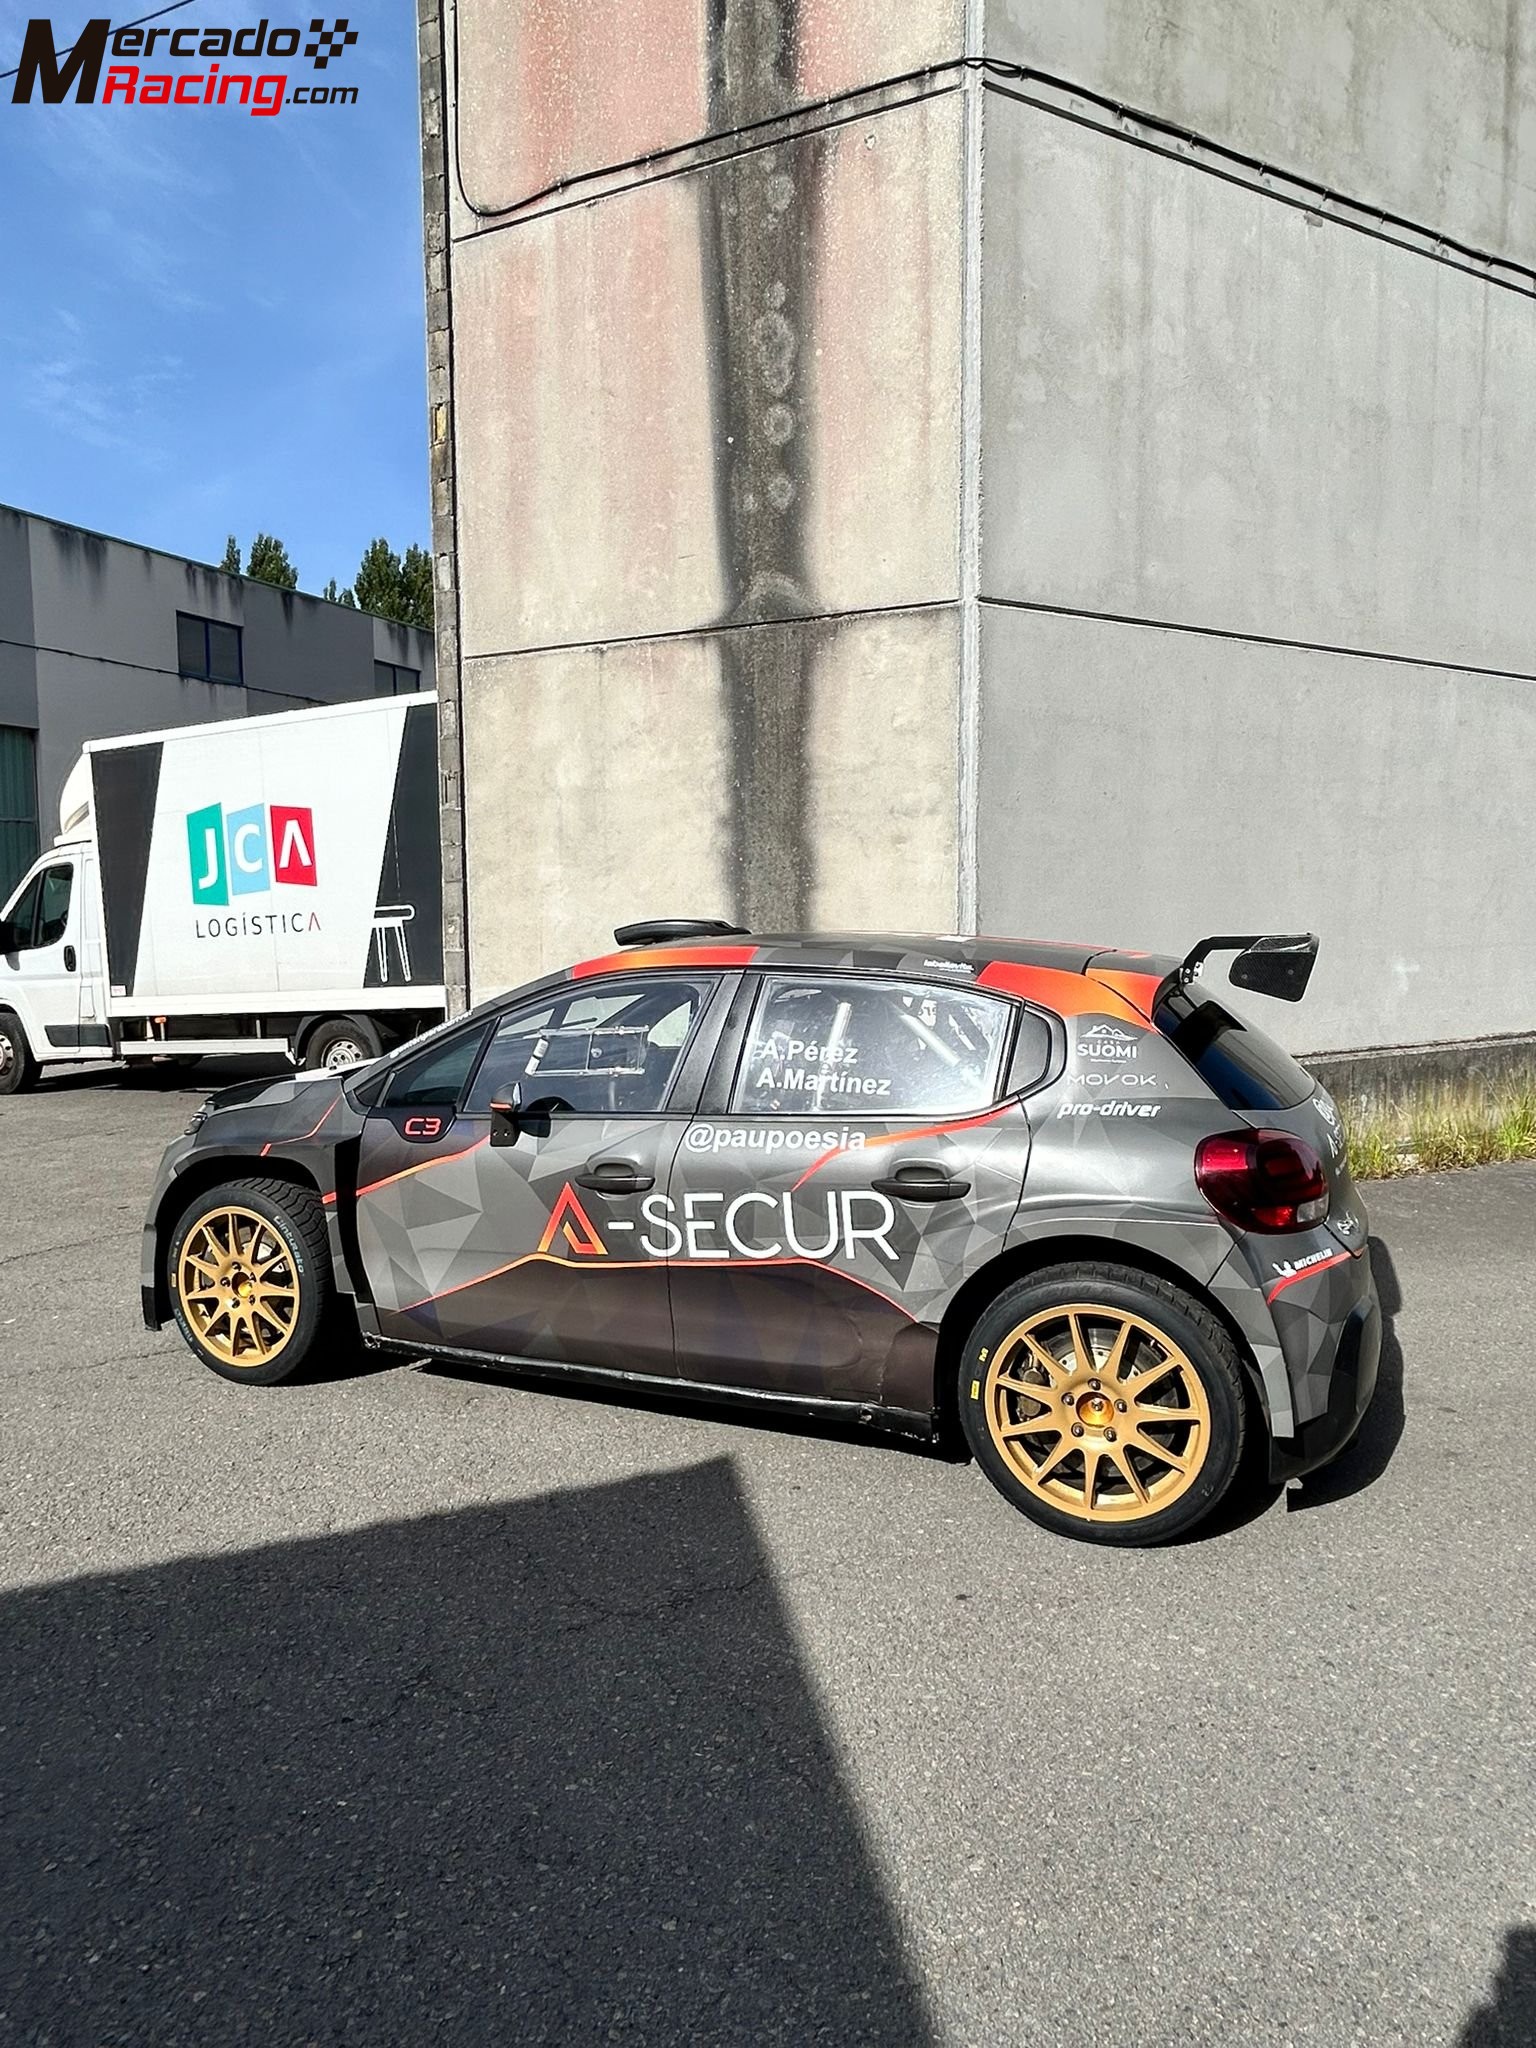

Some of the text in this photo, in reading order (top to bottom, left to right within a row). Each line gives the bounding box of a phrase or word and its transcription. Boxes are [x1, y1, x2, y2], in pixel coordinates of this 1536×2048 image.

[199, 819, 312, 890] JCA
[196, 912, 321, 938] LOGÍSTICA
[760, 1038, 859, 1064] A.Pérez
[1077, 1043, 1137, 1059] SUOMI
[756, 1067, 892, 1096] A.Martínez
[1057, 1100, 1161, 1119] pro-driver
[405, 1118, 442, 1135] C3
[684, 1123, 866, 1153] @paupoesia
[1293, 1247, 1334, 1271] MICHELIN
